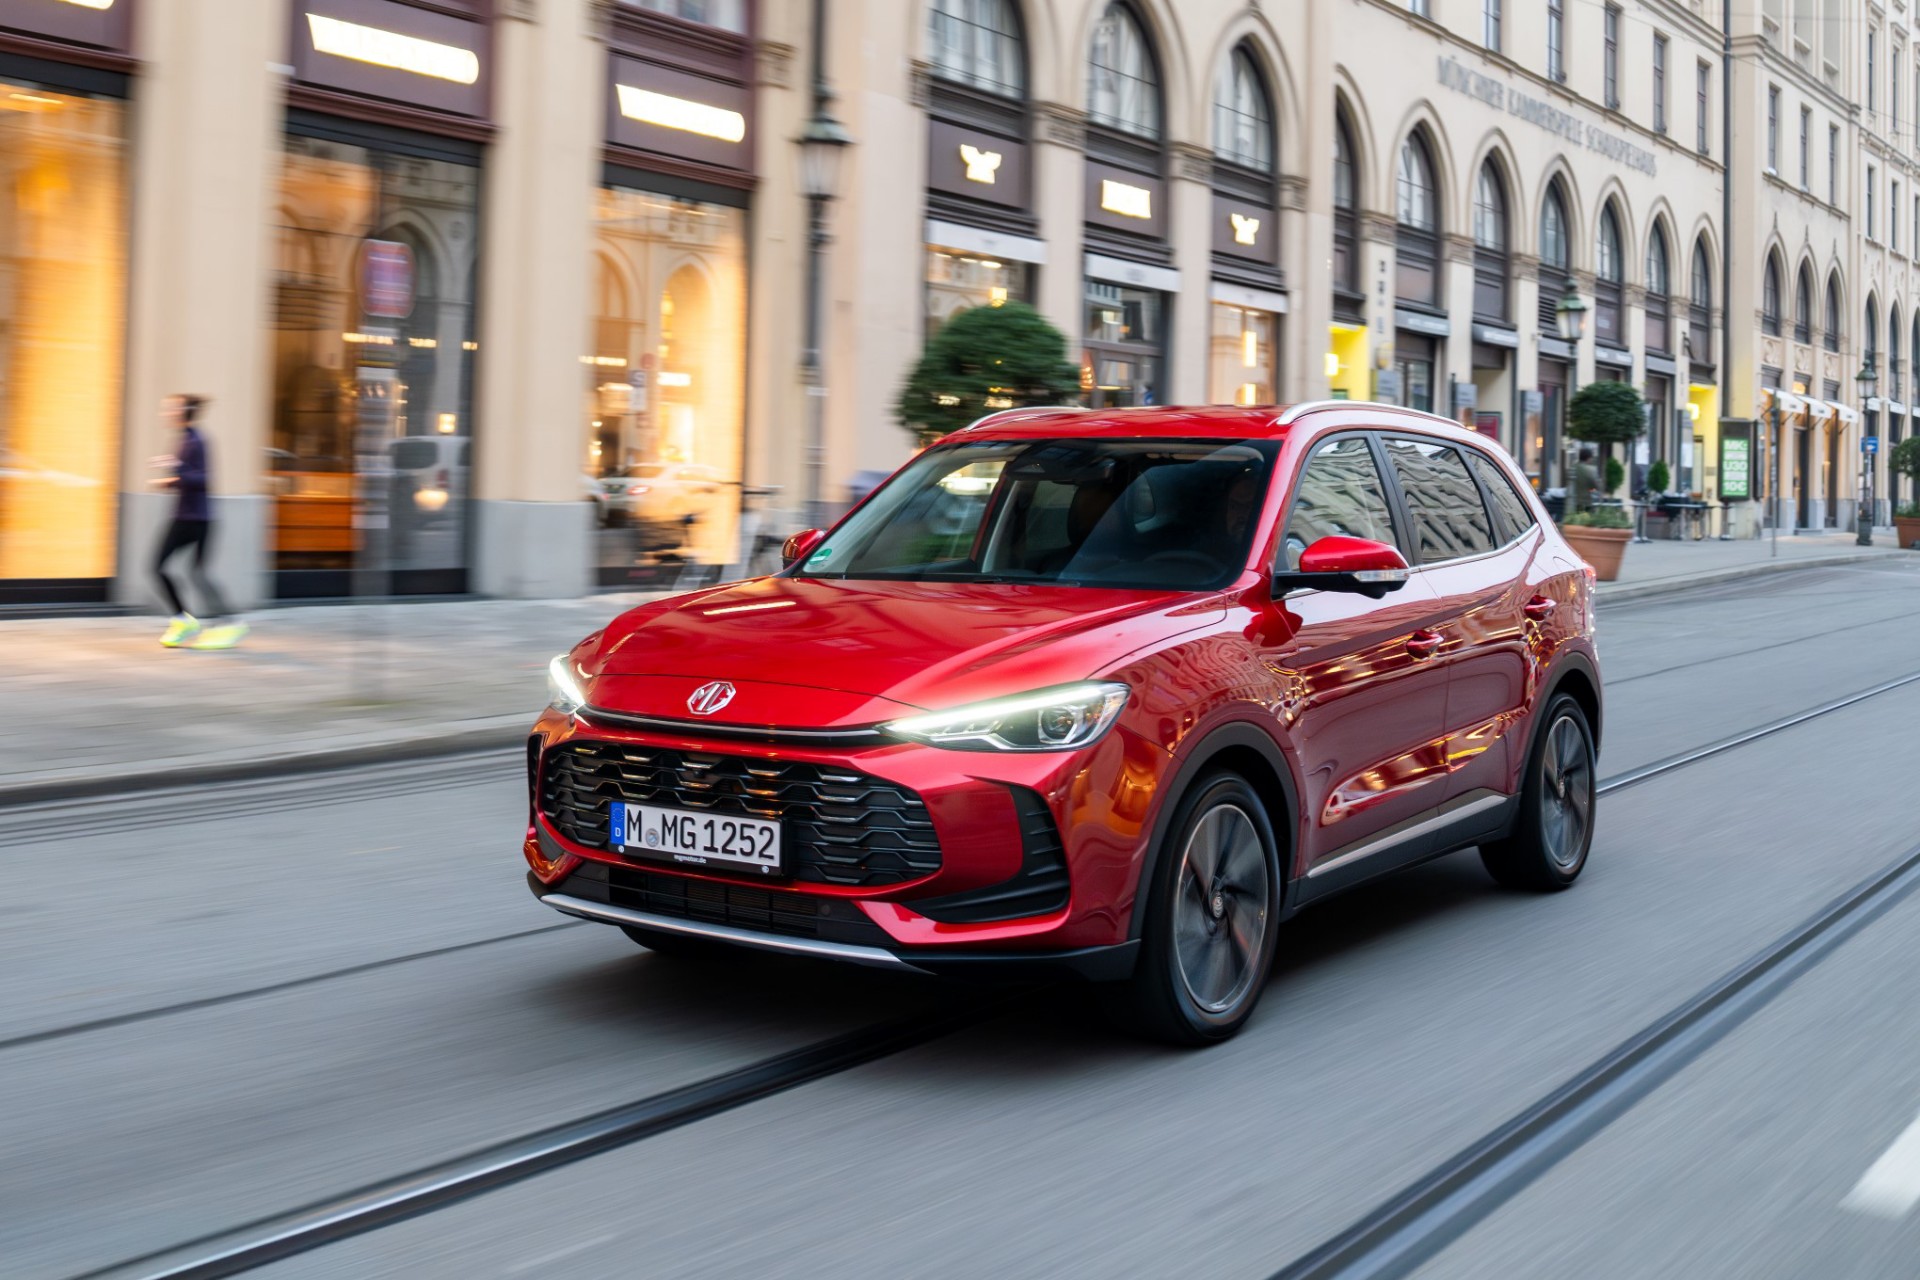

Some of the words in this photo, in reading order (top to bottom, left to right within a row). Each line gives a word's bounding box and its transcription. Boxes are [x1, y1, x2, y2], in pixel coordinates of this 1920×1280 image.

[688, 682, 735, 713] MG
[626, 809, 642, 842] M
[661, 813, 696, 849] MG
[703, 819, 775, 860] 1252
